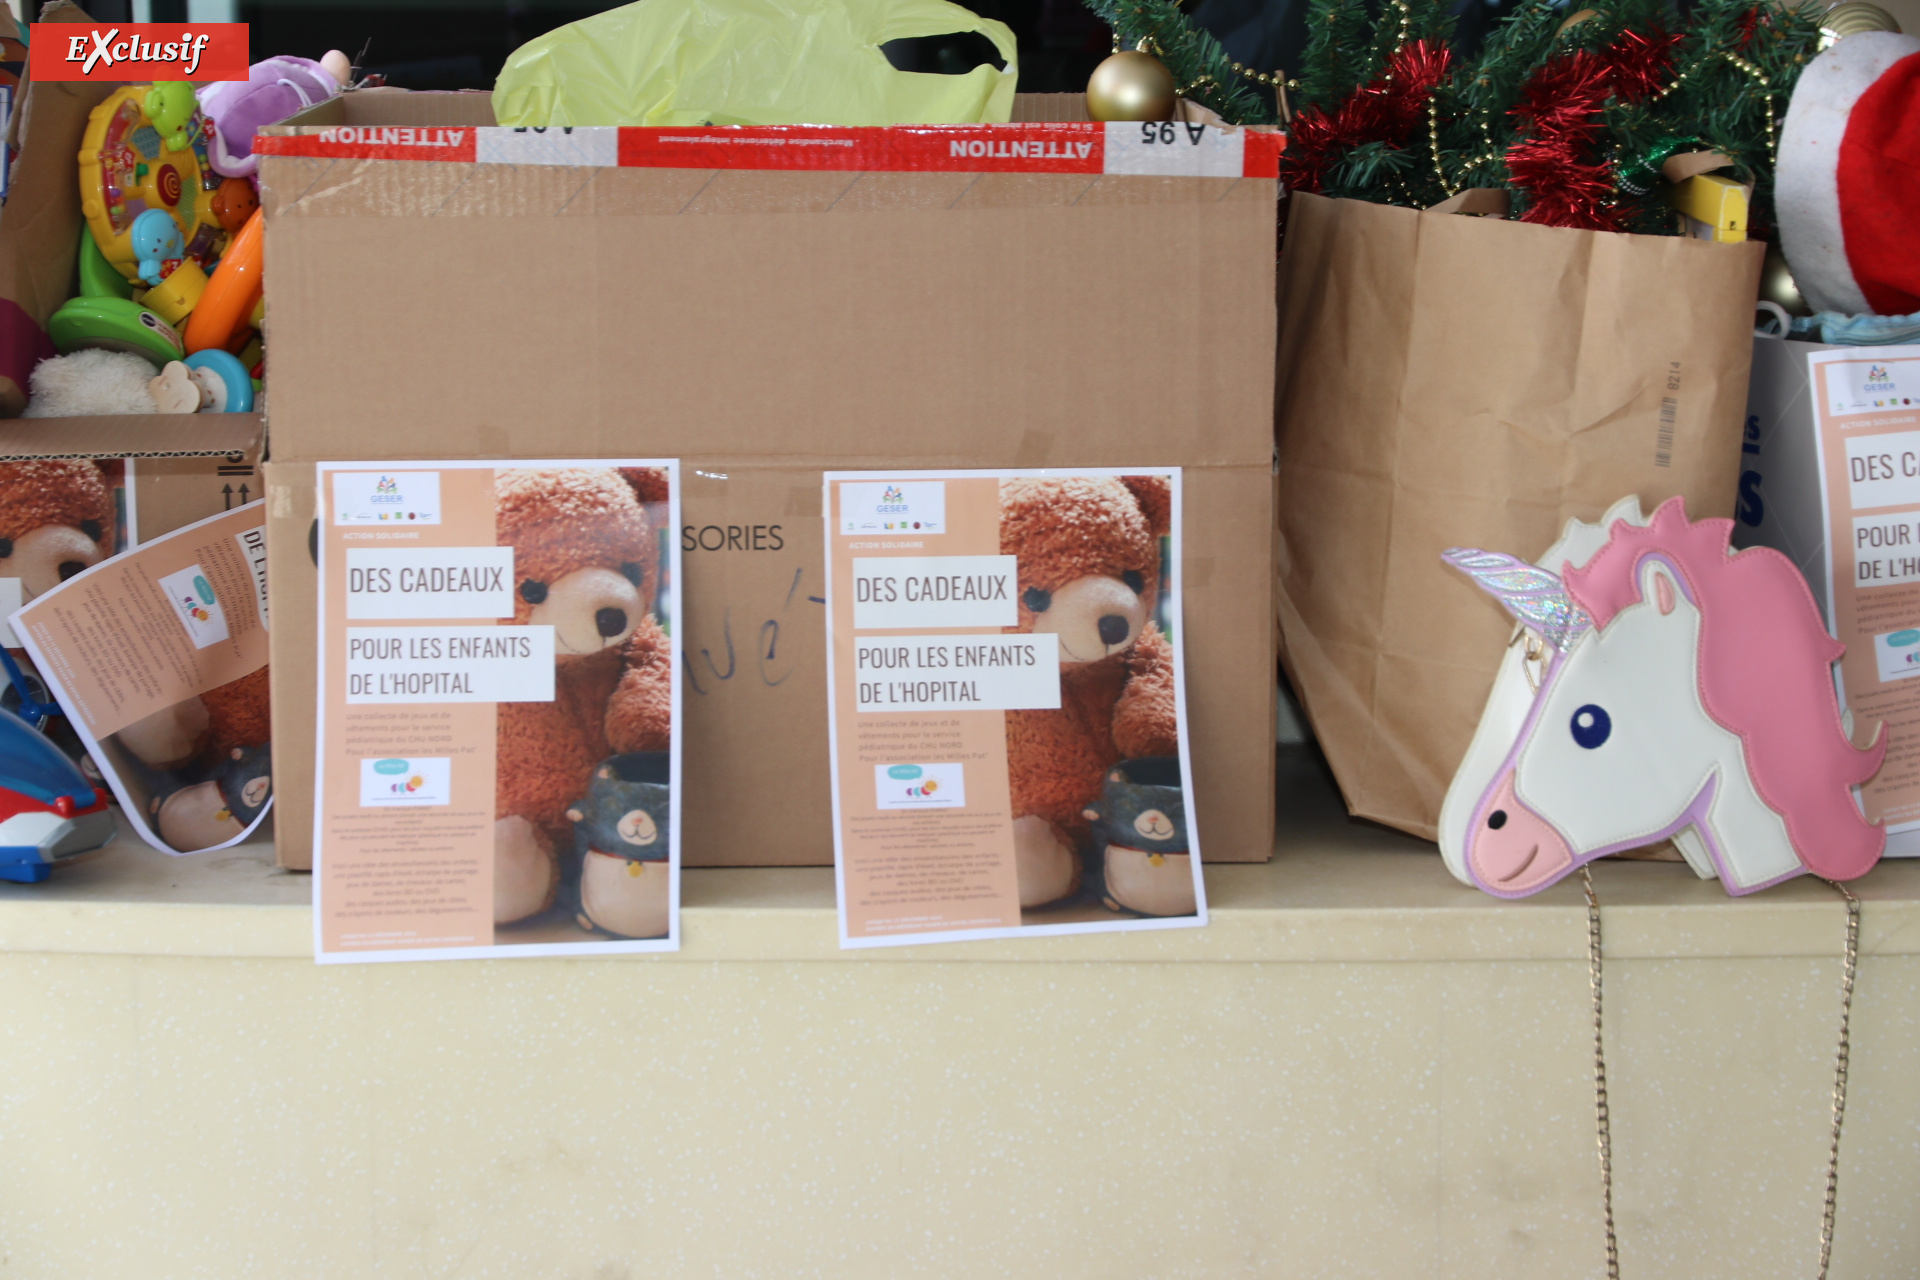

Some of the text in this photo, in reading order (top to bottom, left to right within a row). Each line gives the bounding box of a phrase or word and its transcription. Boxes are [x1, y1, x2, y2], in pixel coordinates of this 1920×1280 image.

[319, 127, 466, 147] ATTENTION
[1142, 121, 1206, 145] A 95
[950, 140, 1093, 159] ATTENTION
[1667, 361, 1681, 391] 8214
[1864, 382, 1896, 391] GESER
[1840, 416, 1917, 429] ACTION SOLIDAIRE
[1851, 454, 1894, 482] DES
[370, 495, 403, 503] GESER
[876, 505, 909, 513] GESER
[1857, 524, 1911, 549] POUR
[350, 566, 503, 593] DES CADEAUX
[1858, 557, 1920, 580] DE L'H
[857, 575, 1007, 602] DES CADEAUX
[350, 636, 531, 660] POUR LES ENFANTS
[858, 645, 1036, 669] POUR LES ENFANTS
[350, 672, 473, 695] DE L'HOPITAL
[860, 680, 981, 704] DE L'HOPITAL
